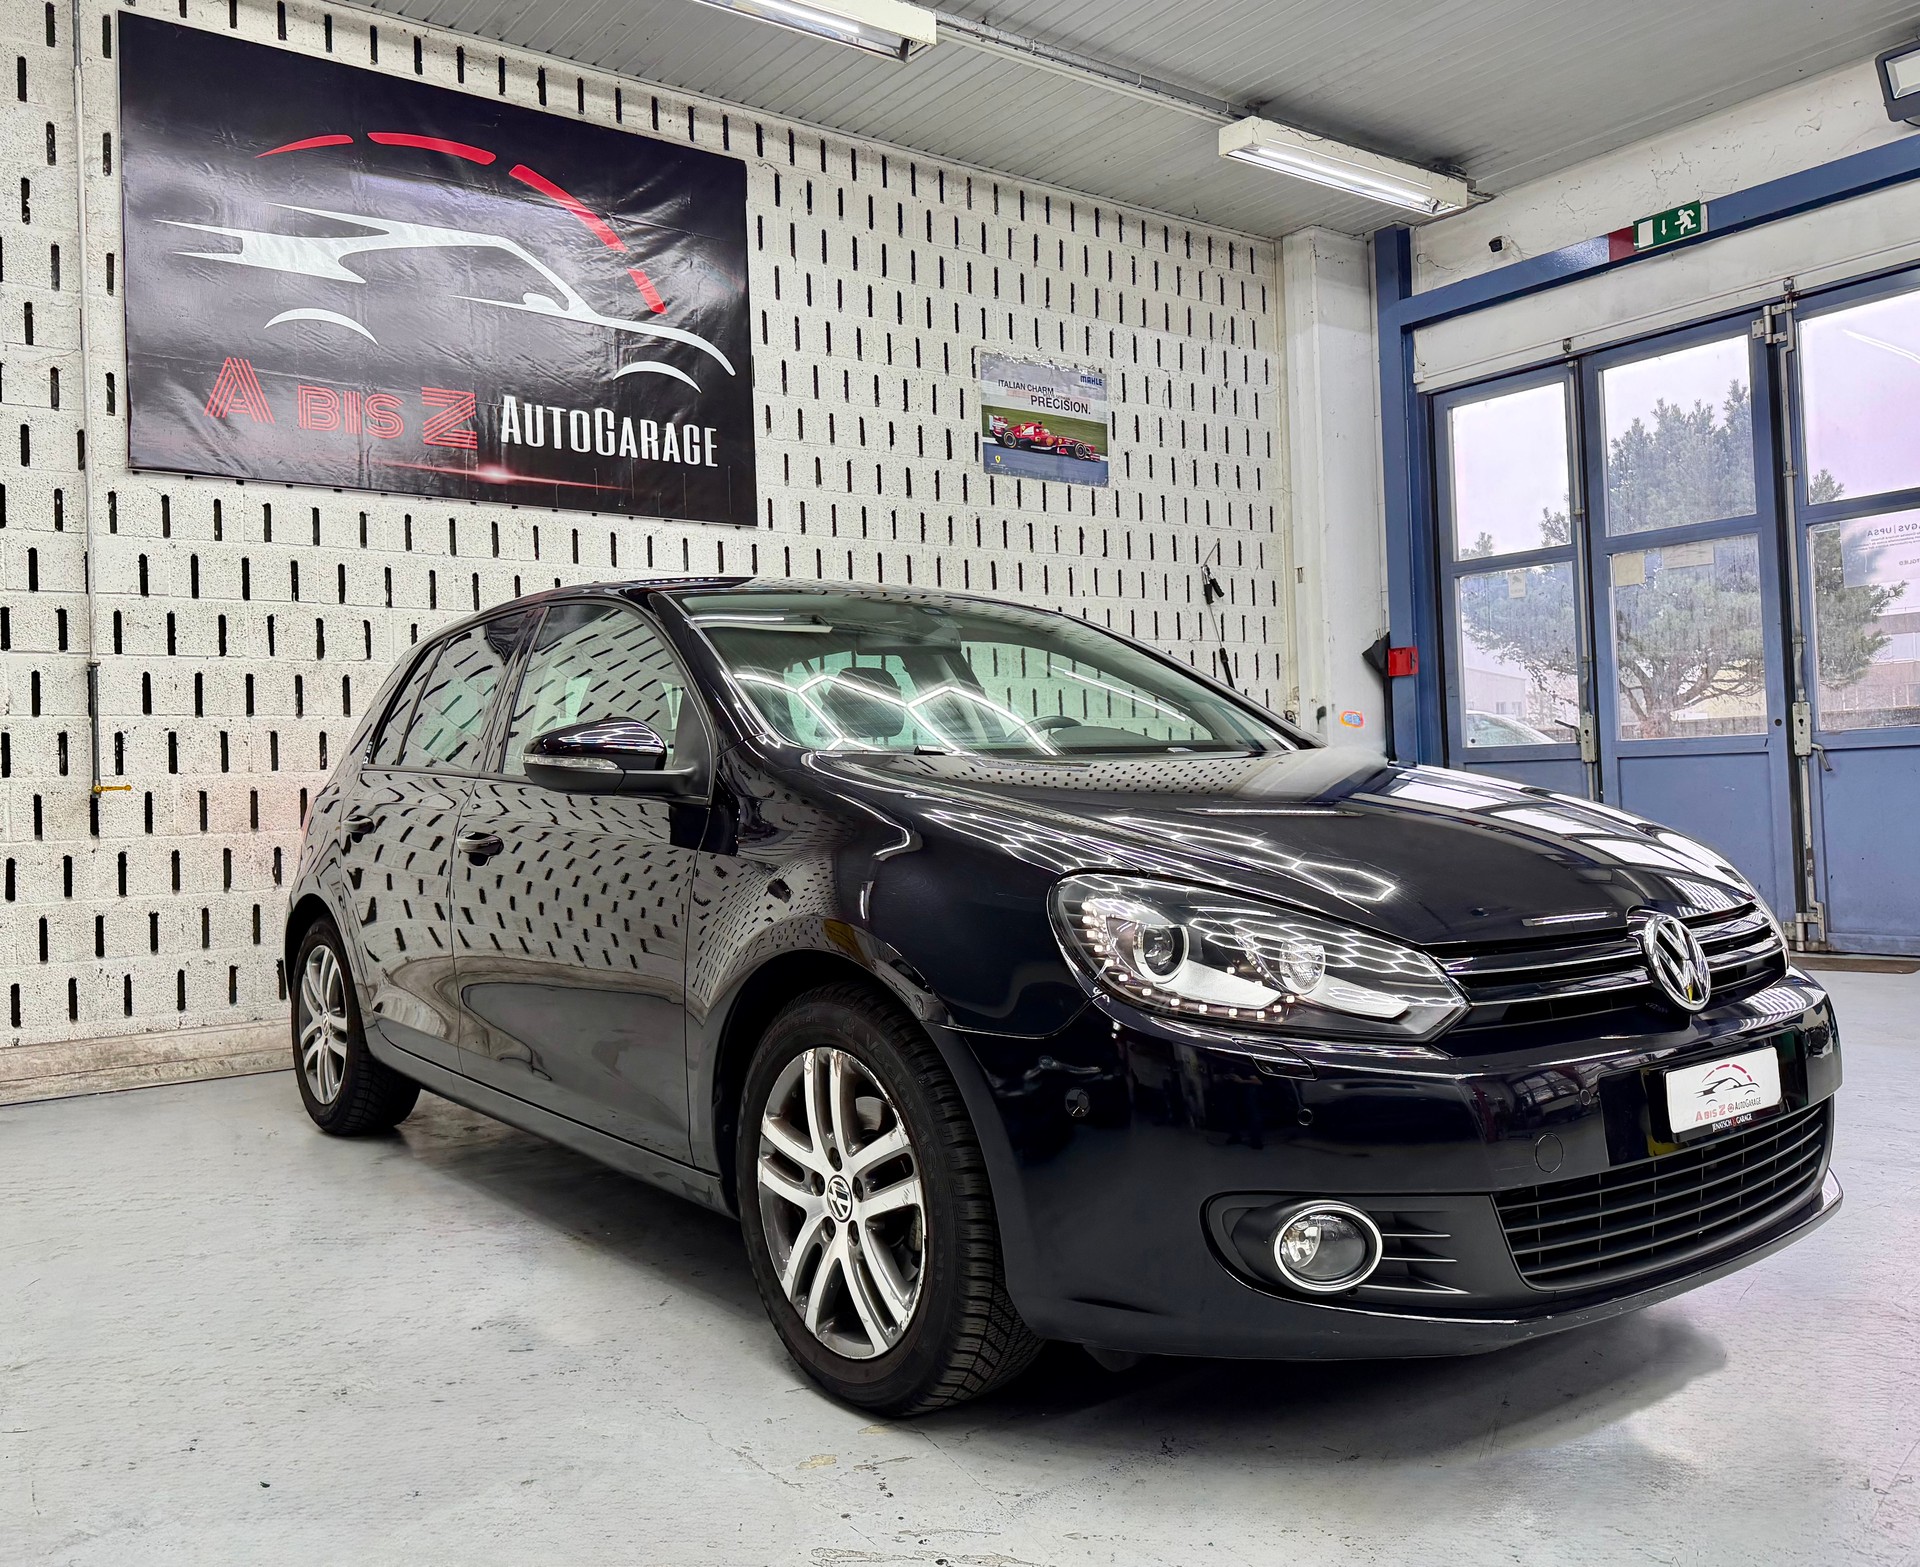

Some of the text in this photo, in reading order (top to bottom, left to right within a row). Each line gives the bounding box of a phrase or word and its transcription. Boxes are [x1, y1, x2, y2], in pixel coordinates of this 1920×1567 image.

[998, 379, 1026, 391] ITALIAN
[1080, 375, 1103, 386] MAHLE
[204, 357, 275, 424] A
[421, 386, 478, 450] Z
[1030, 395, 1091, 415] PRECISION.
[1695, 1110, 1703, 1122] A
[1718, 1104, 1726, 1116] Z
